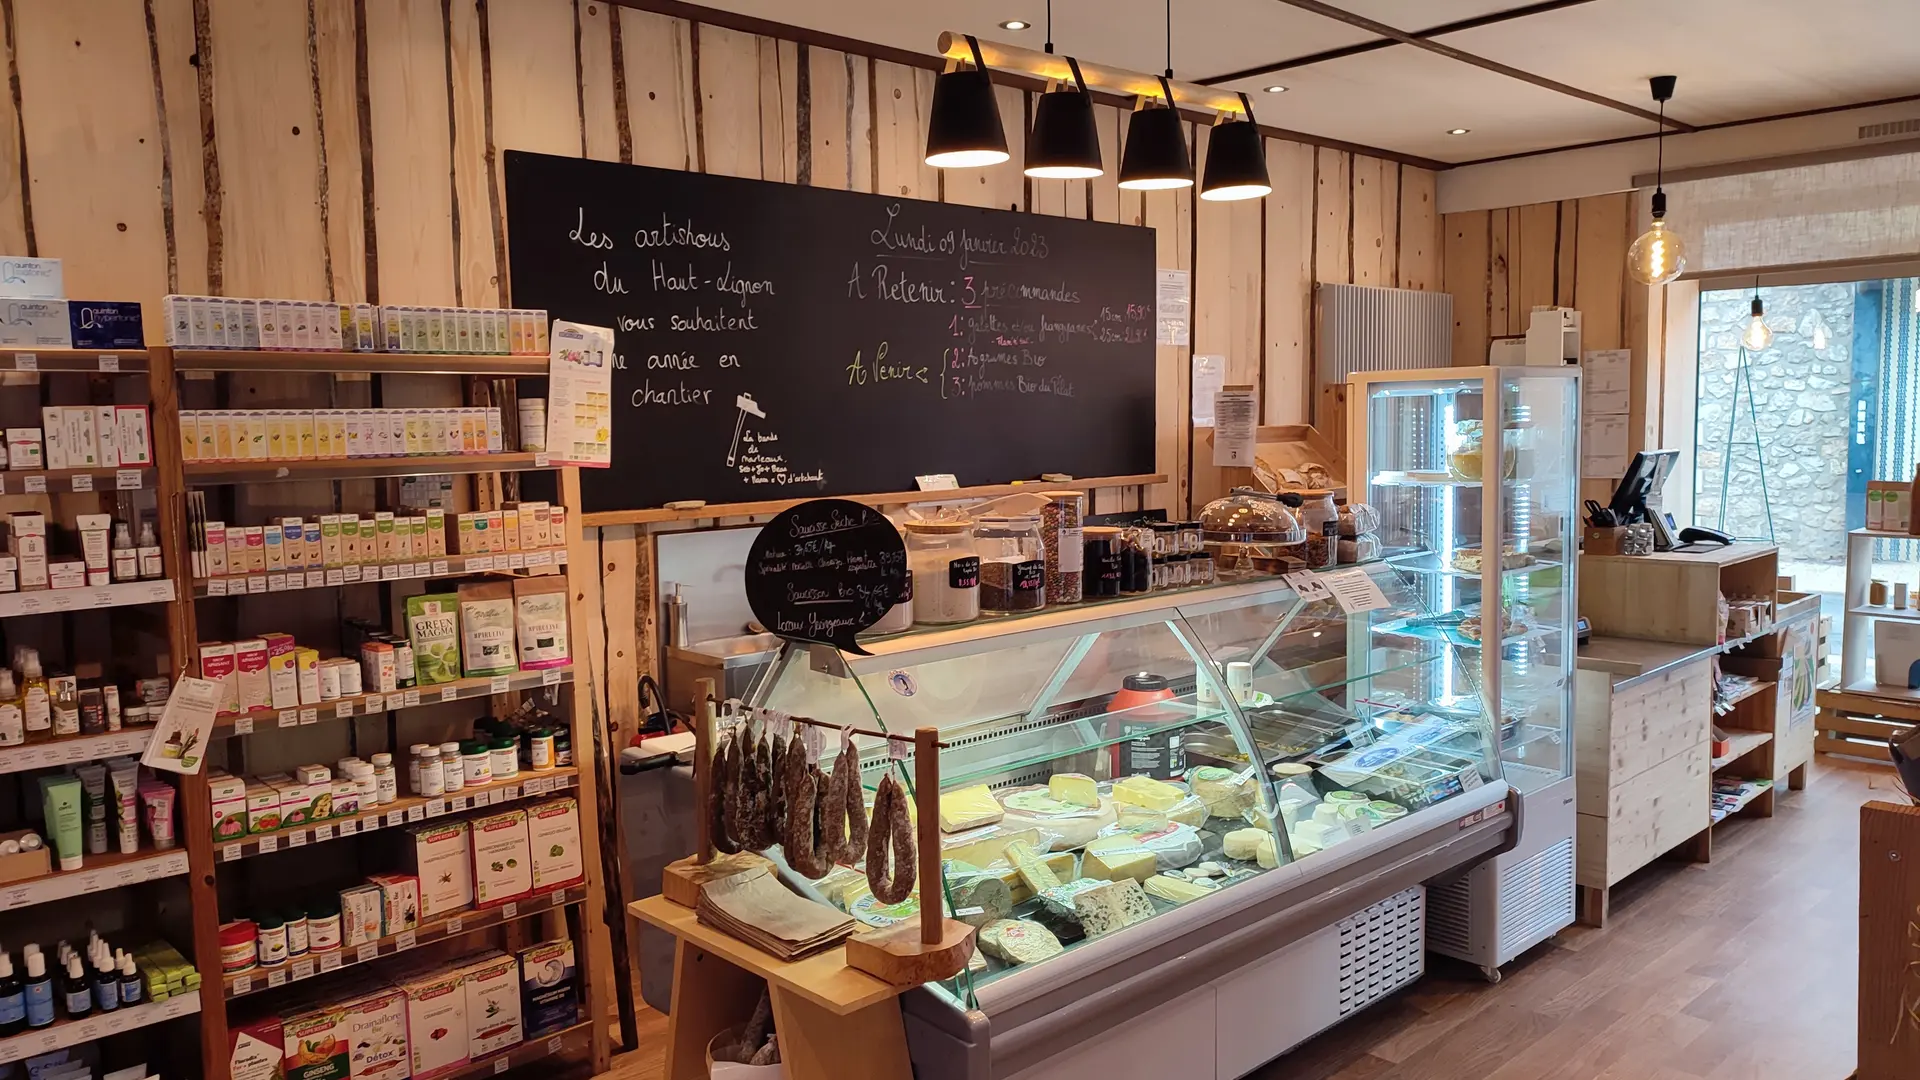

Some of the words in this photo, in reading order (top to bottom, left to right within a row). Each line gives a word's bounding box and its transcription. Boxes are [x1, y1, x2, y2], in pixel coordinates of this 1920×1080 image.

[568, 206, 614, 251] Les
[871, 203, 937, 254] Lundi
[939, 231, 955, 254] 09
[1010, 227, 1049, 259] 2023
[593, 261, 630, 295] du
[847, 262, 868, 300] A
[961, 276, 977, 306] 3
[92, 308, 119, 316] quinton
[617, 314, 655, 333] vous
[670, 306, 759, 333] souhaitent
[611, 353, 628, 370] ne
[647, 351, 700, 371] année
[719, 353, 741, 370] en
[846, 350, 867, 386] A
[1022, 349, 1047, 367] Bio
[631, 378, 714, 408] chantier
[1017, 375, 1036, 393] Bio
[1038, 380, 1051, 393] du
[415, 617, 453, 631] GREEN
[417, 626, 453, 639] MAGMA
[352, 1012, 402, 1033] Drainaflore
[366, 1049, 394, 1064] Détox
[303, 1063, 335, 1079] GINSENG
